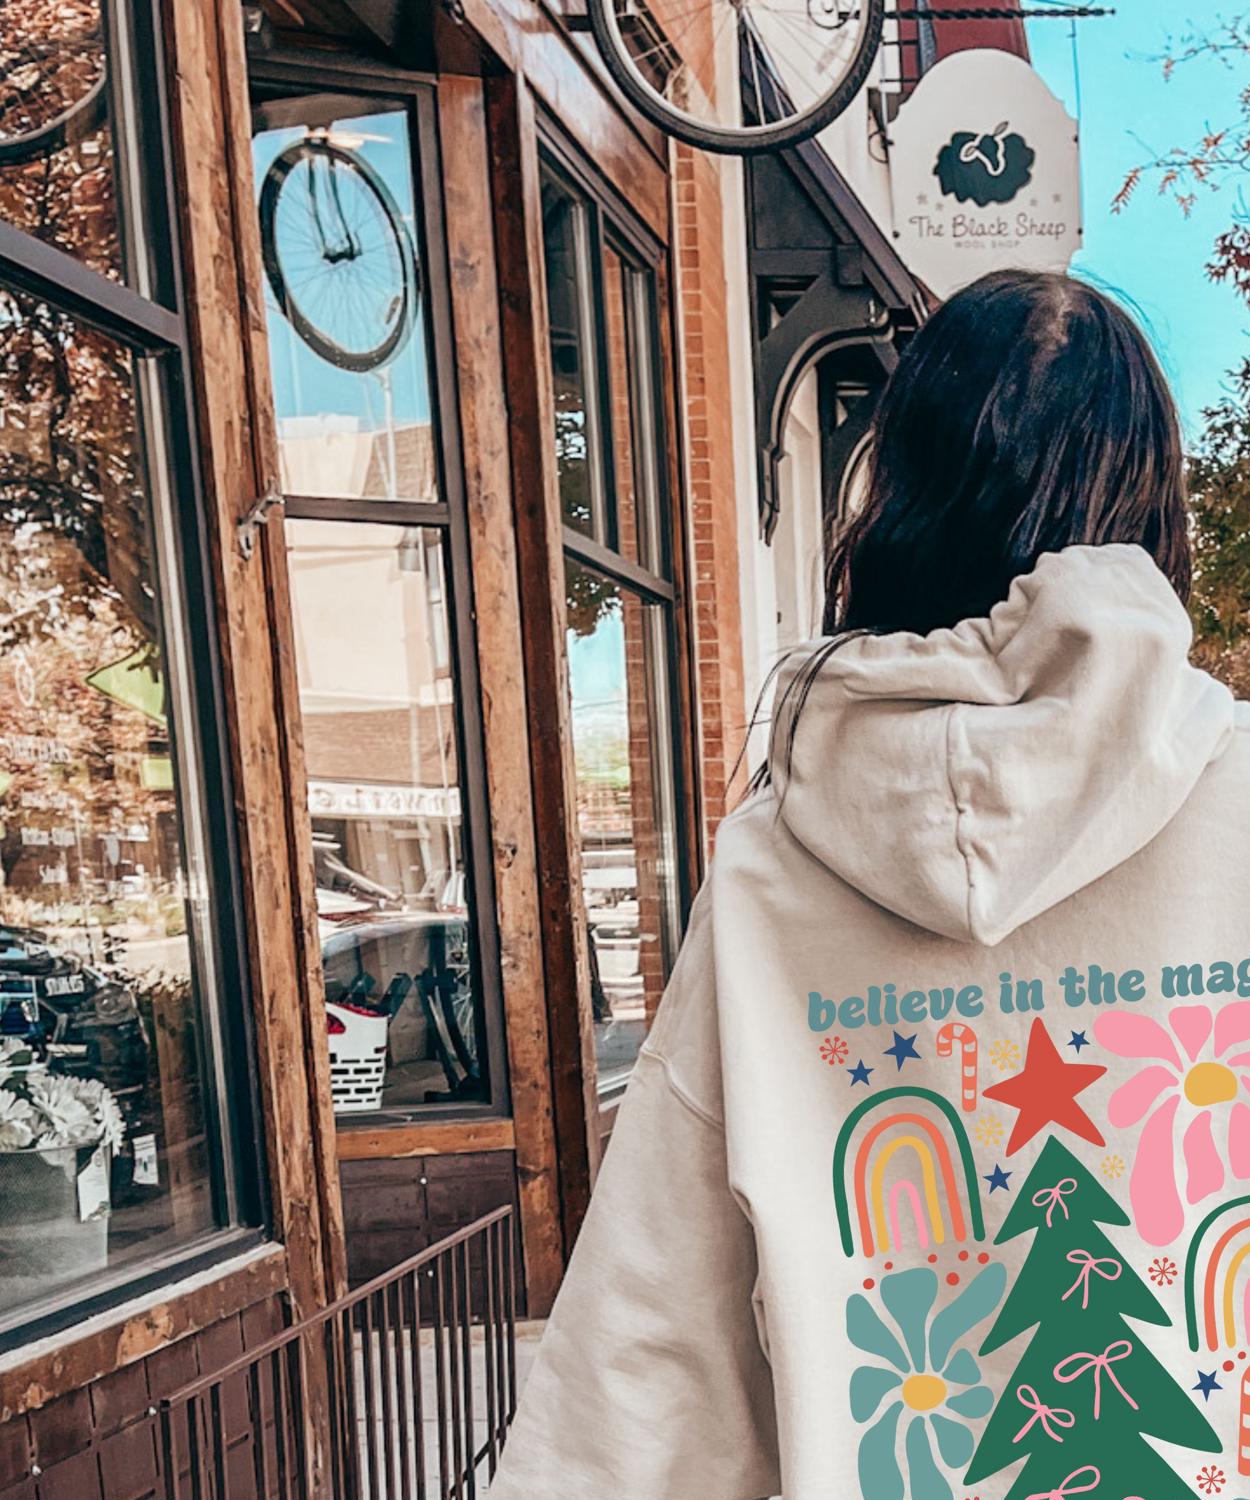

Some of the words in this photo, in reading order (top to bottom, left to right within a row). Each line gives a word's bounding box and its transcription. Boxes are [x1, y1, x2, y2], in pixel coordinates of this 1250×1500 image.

[909, 216, 944, 237] The
[952, 214, 1008, 238] Black
[1016, 212, 1066, 241] Sheep
[808, 984, 984, 1032] believe
[999, 972, 1044, 1013] in
[1059, 964, 1146, 1008] the
